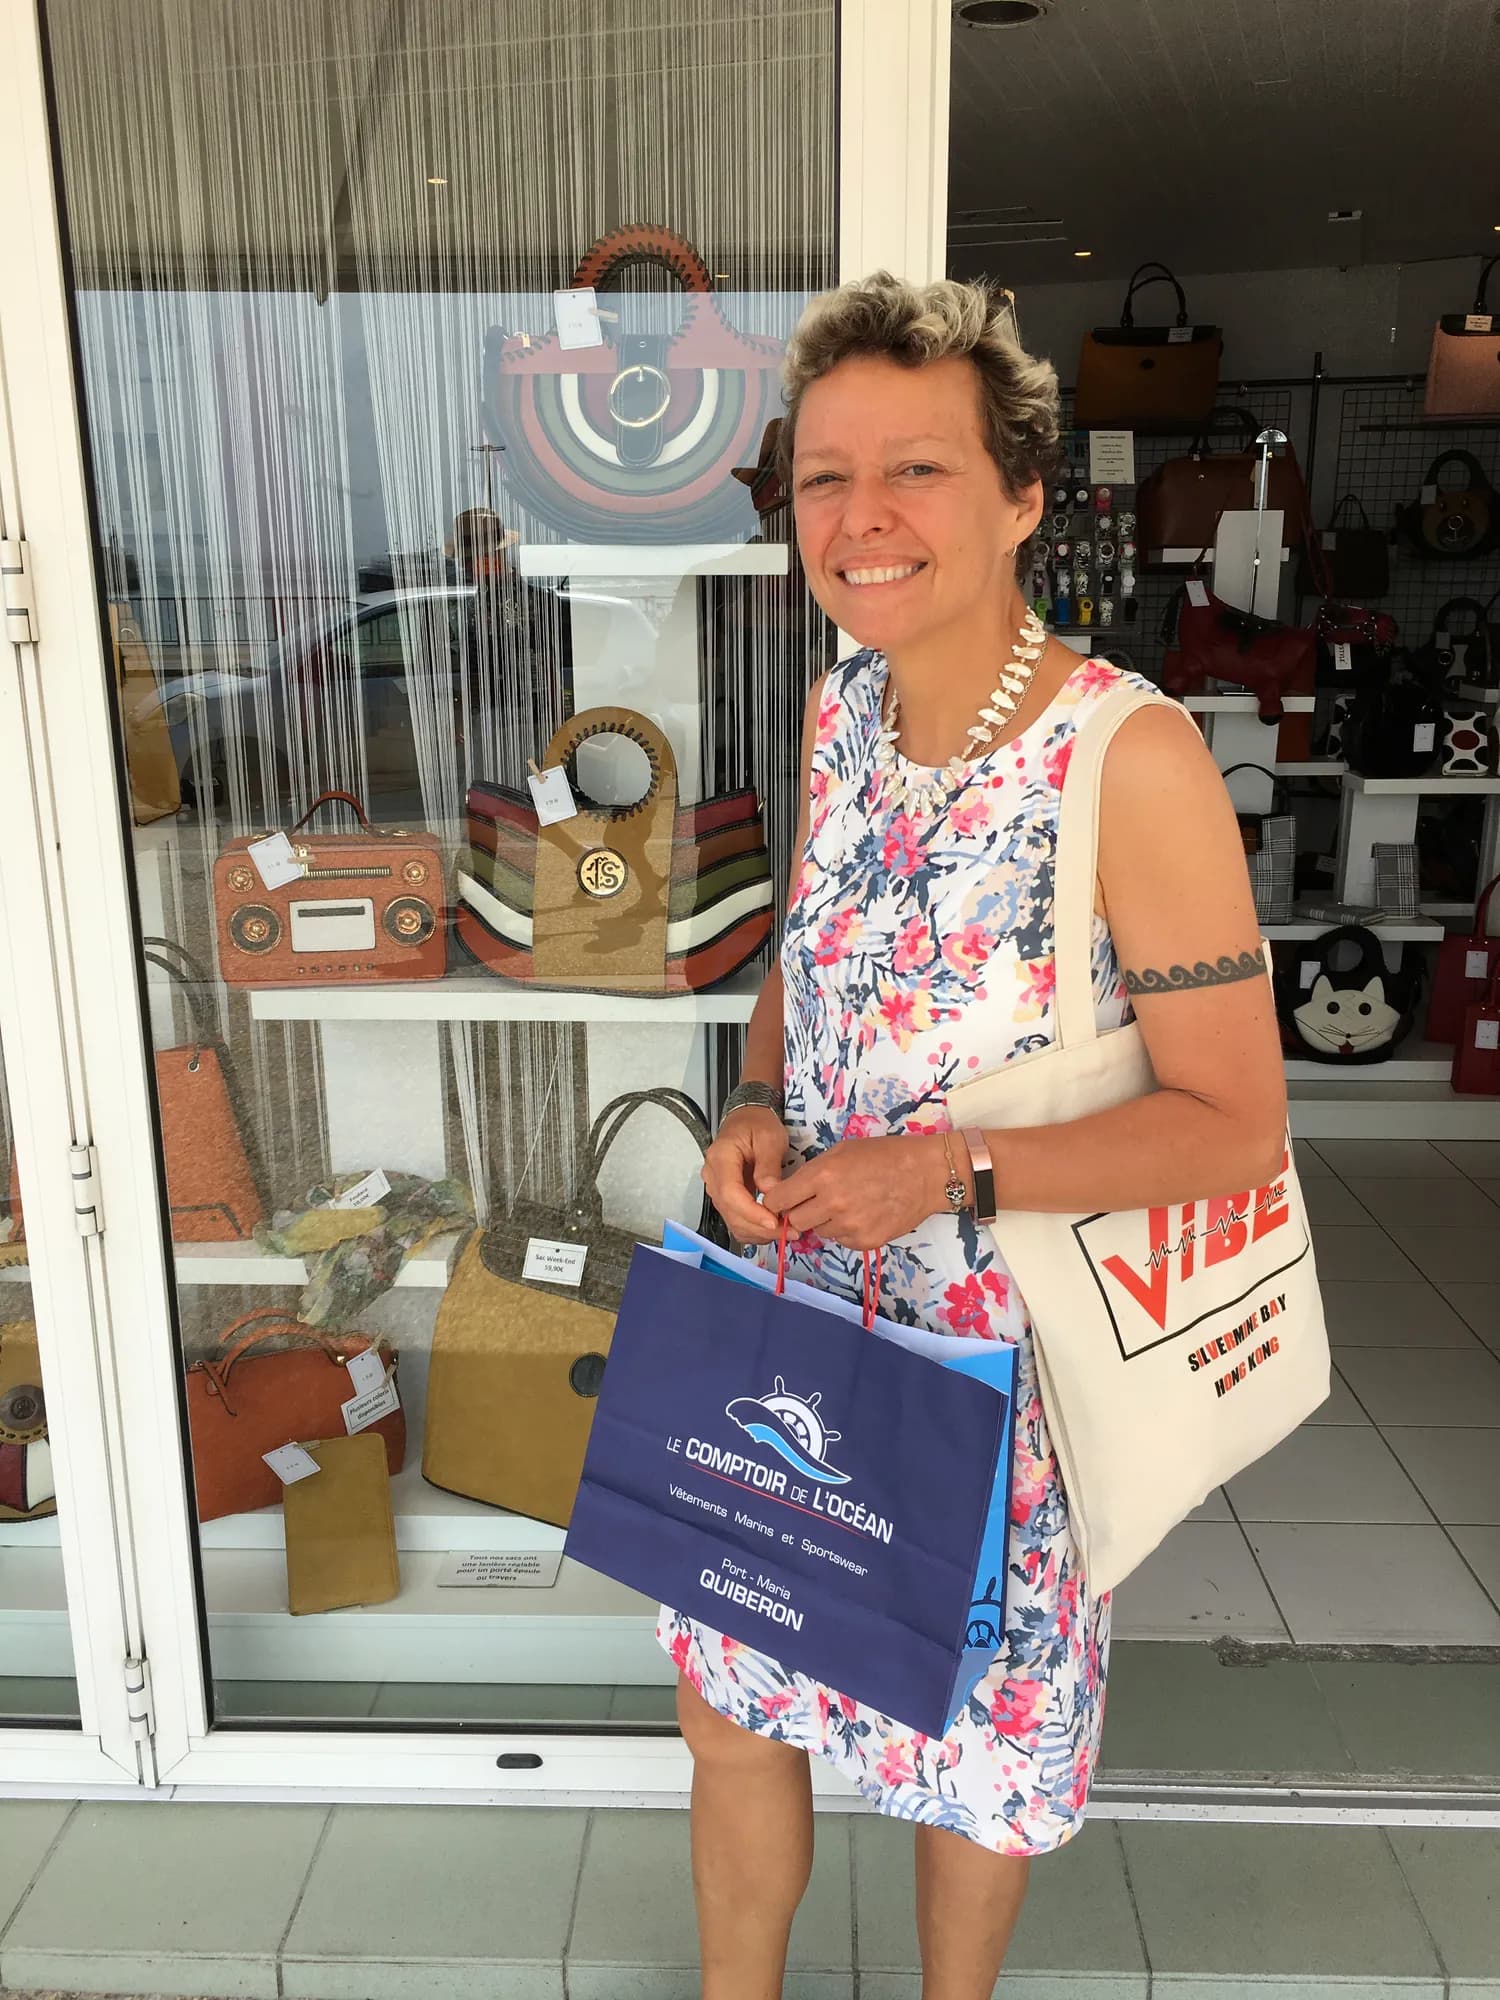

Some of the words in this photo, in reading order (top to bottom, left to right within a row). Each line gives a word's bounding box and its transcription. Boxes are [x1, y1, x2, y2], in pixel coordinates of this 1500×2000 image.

[535, 1253, 546, 1261] Sac
[1187, 1311, 1259, 1372] SILVERMINE
[1260, 1293, 1287, 1323] BAY
[1214, 1361, 1247, 1398] HONG
[1247, 1336, 1280, 1372] KONG
[666, 1436, 682, 1454] LE
[685, 1437, 788, 1495] COMPTOIR
[790, 1485, 809, 1504] DE
[812, 1486, 894, 1545] L'OCÉAN
[669, 1483, 729, 1518] Vêtements
[734, 1511, 775, 1537] Marins
[781, 1533, 795, 1545] et
[801, 1538, 869, 1577] Sportswear
[700, 1568, 804, 1632] QUIBERON
[721, 1557, 748, 1580] Port
[756, 1574, 791, 1601] Maria
